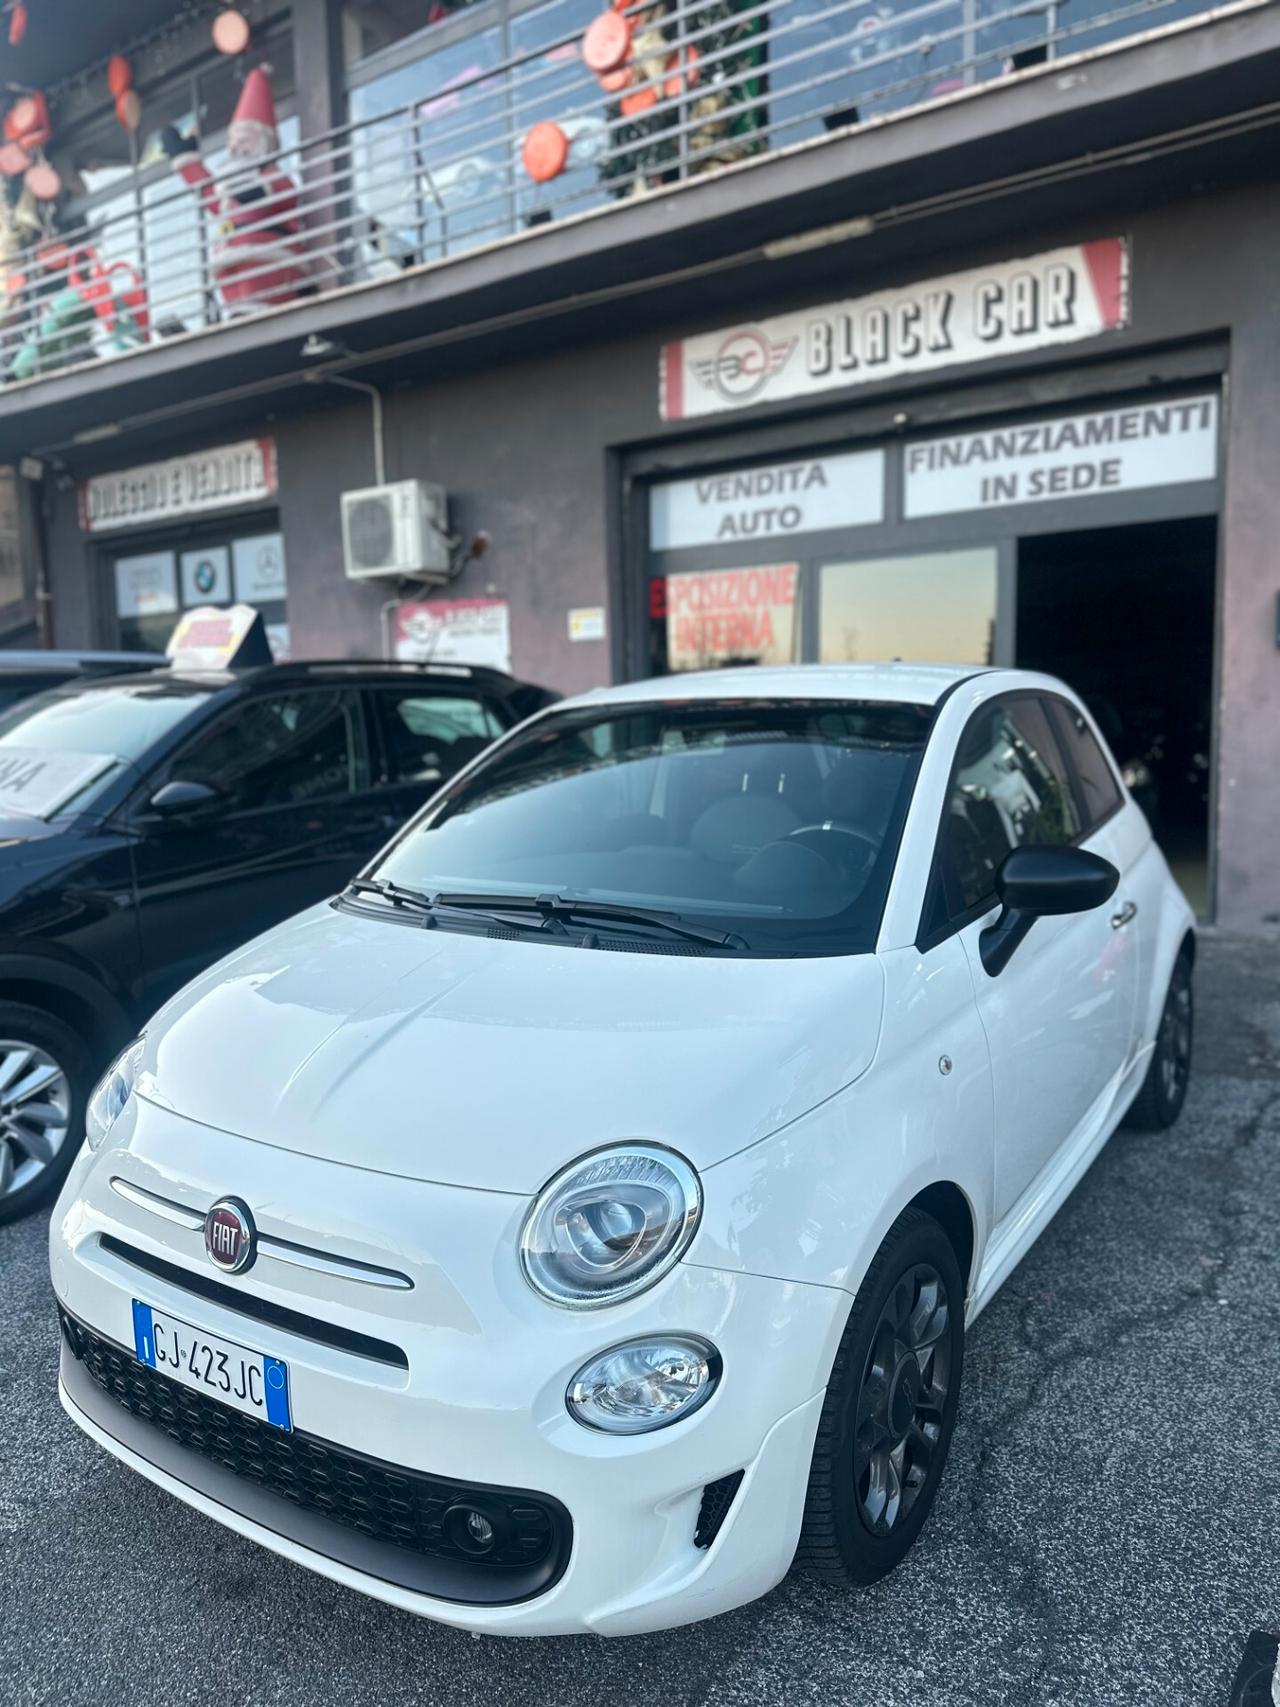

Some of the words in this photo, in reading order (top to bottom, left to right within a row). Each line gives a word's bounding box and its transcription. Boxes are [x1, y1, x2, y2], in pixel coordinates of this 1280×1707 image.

[807, 289, 954, 377] BLACK
[973, 263, 1077, 340] CAR
[906, 401, 1211, 474] FINANZIAMENTI
[695, 464, 828, 504] VENDITA
[981, 478, 1017, 502] IN
[1026, 459, 1122, 496] SEDE
[716, 505, 801, 538] AUTO
[676, 610, 775, 653] INTERNA
[212, 1221, 239, 1256] FIAT
